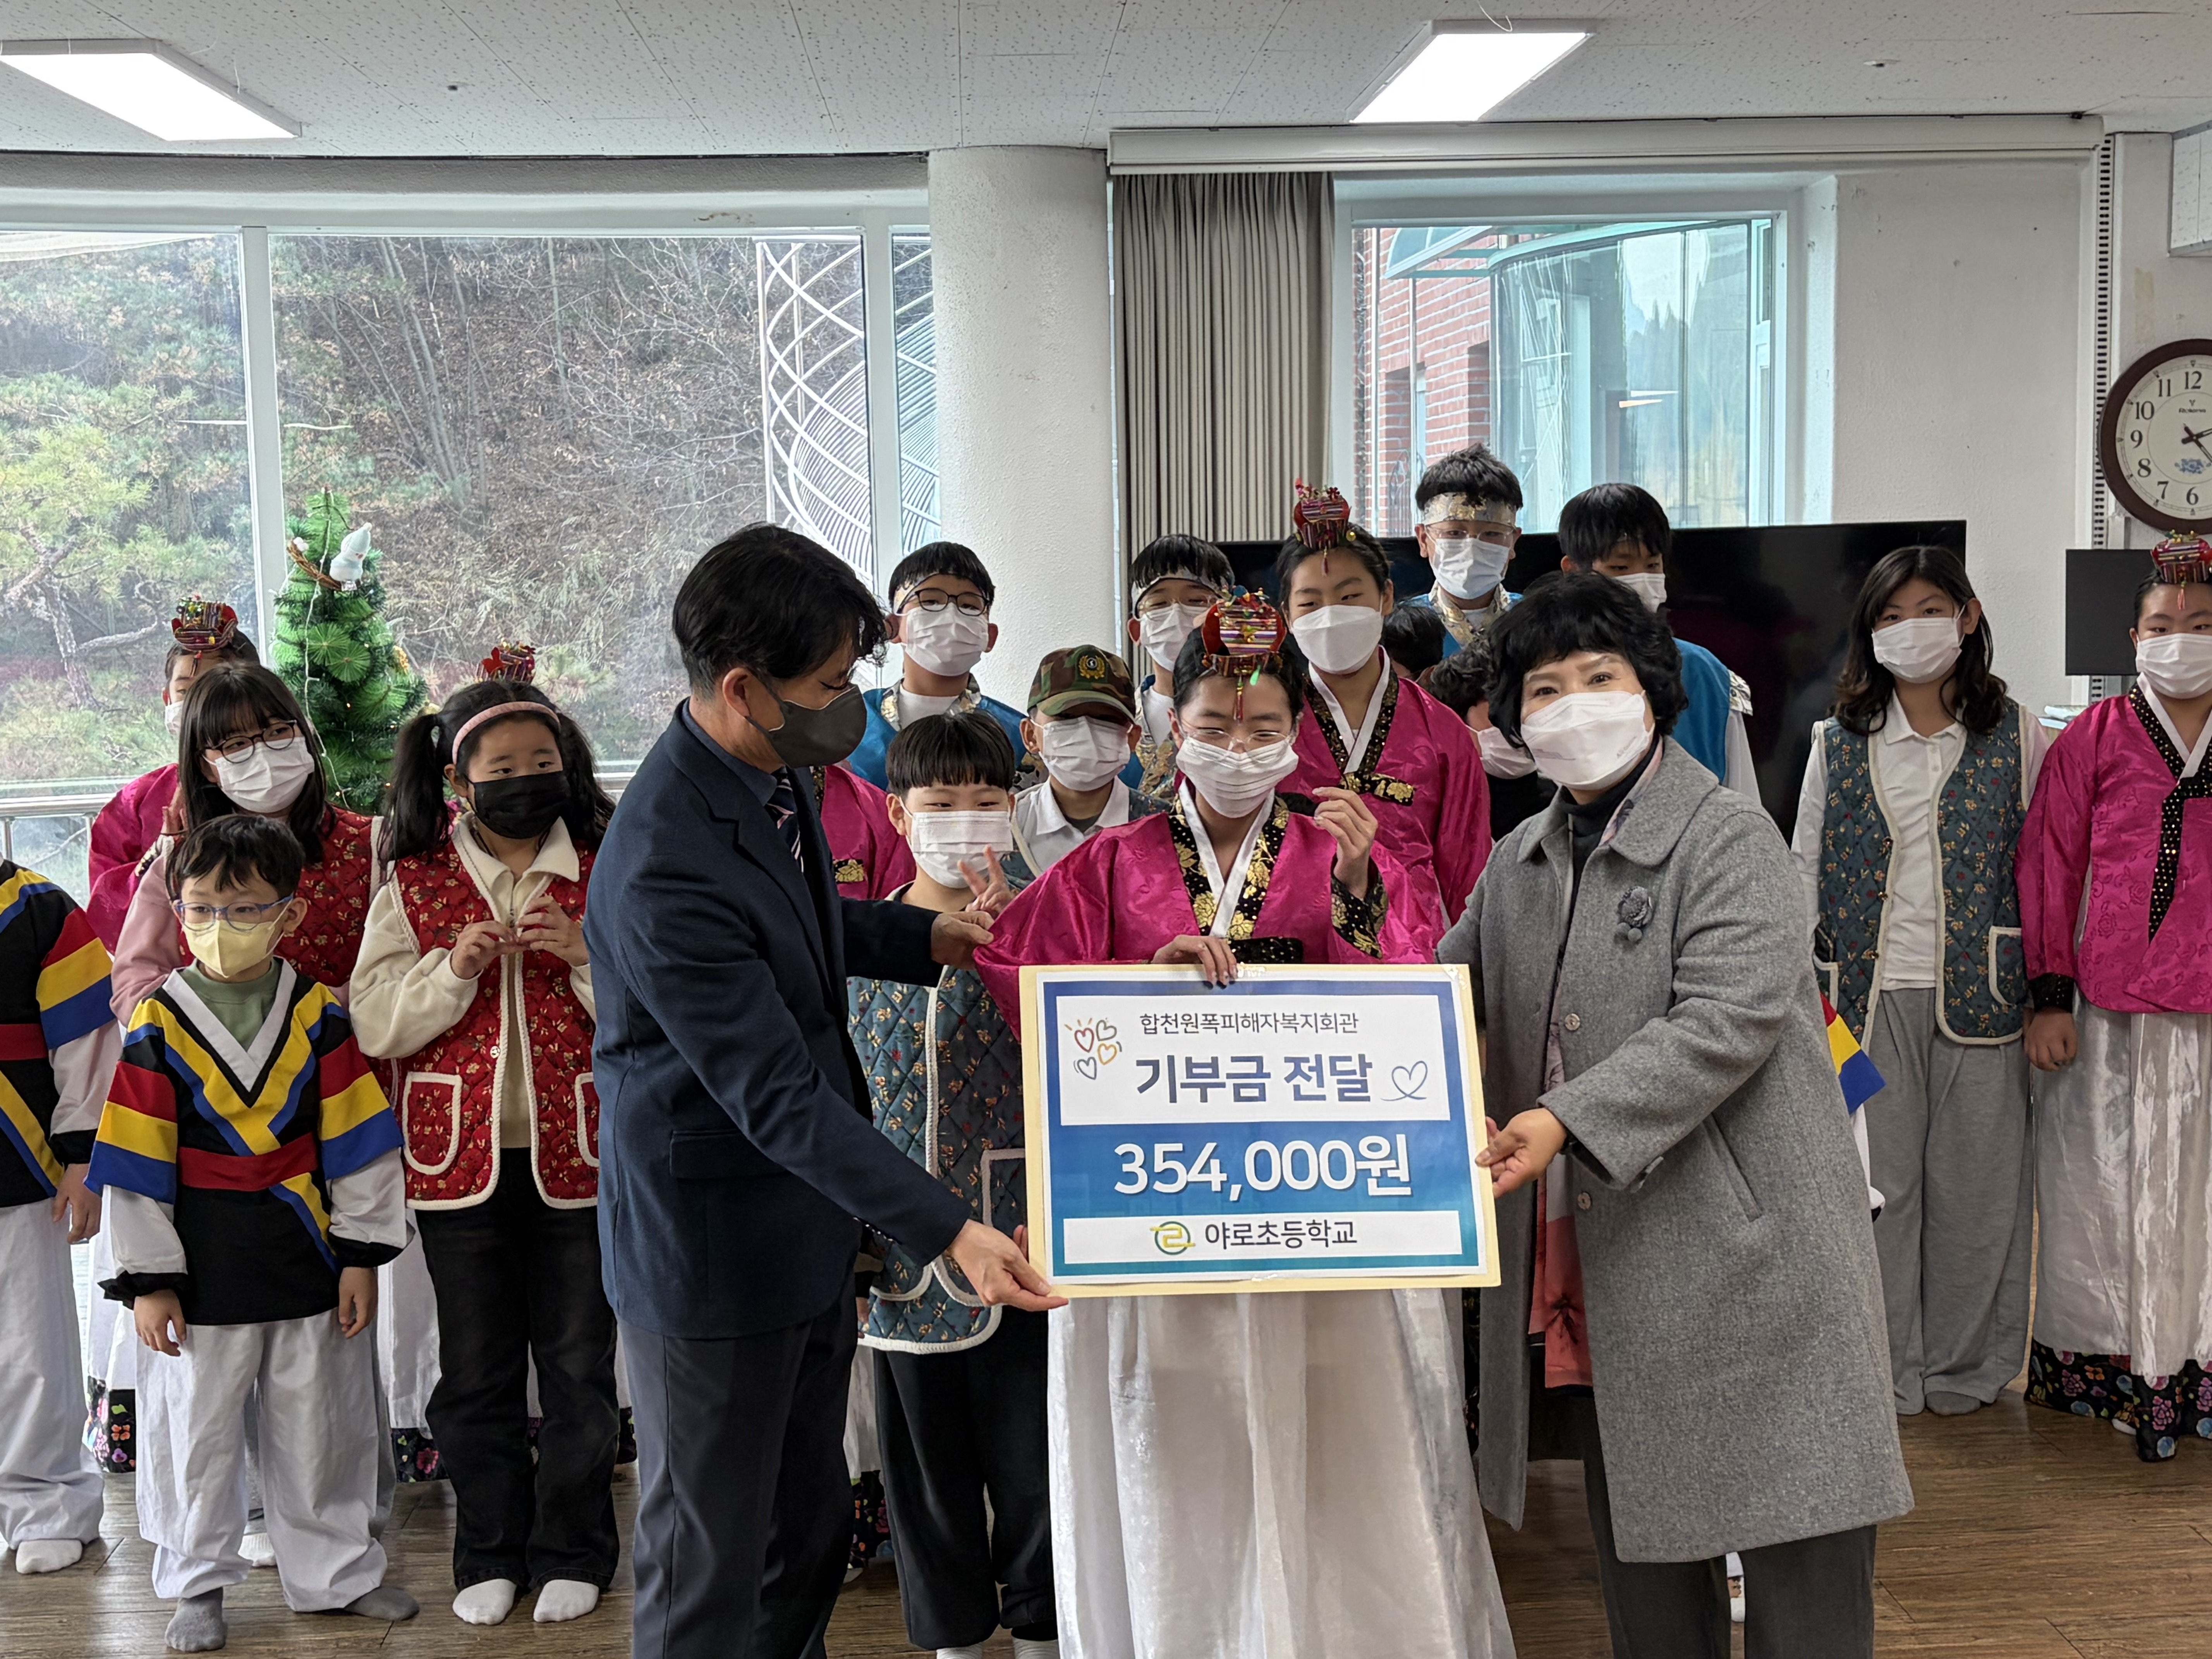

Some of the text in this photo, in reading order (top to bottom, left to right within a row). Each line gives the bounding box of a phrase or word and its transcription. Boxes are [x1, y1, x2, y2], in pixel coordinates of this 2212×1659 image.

[2158, 379, 2171, 397] 11
[2185, 371, 2202, 390] 12
[2135, 401, 2155, 420] 10
[2130, 430, 2143, 448] 9
[2137, 459, 2152, 477] 8
[2157, 481, 2169, 499] 7
[2186, 487, 2199, 505] 6
[1139, 1012, 1359, 1035] 합천원폭피해자복지회관
[1136, 1053, 1373, 1104] 기부금 전달
[1114, 1133, 1412, 1201] 354,000원
[1205, 1219, 1358, 1250] 야로초등학교
